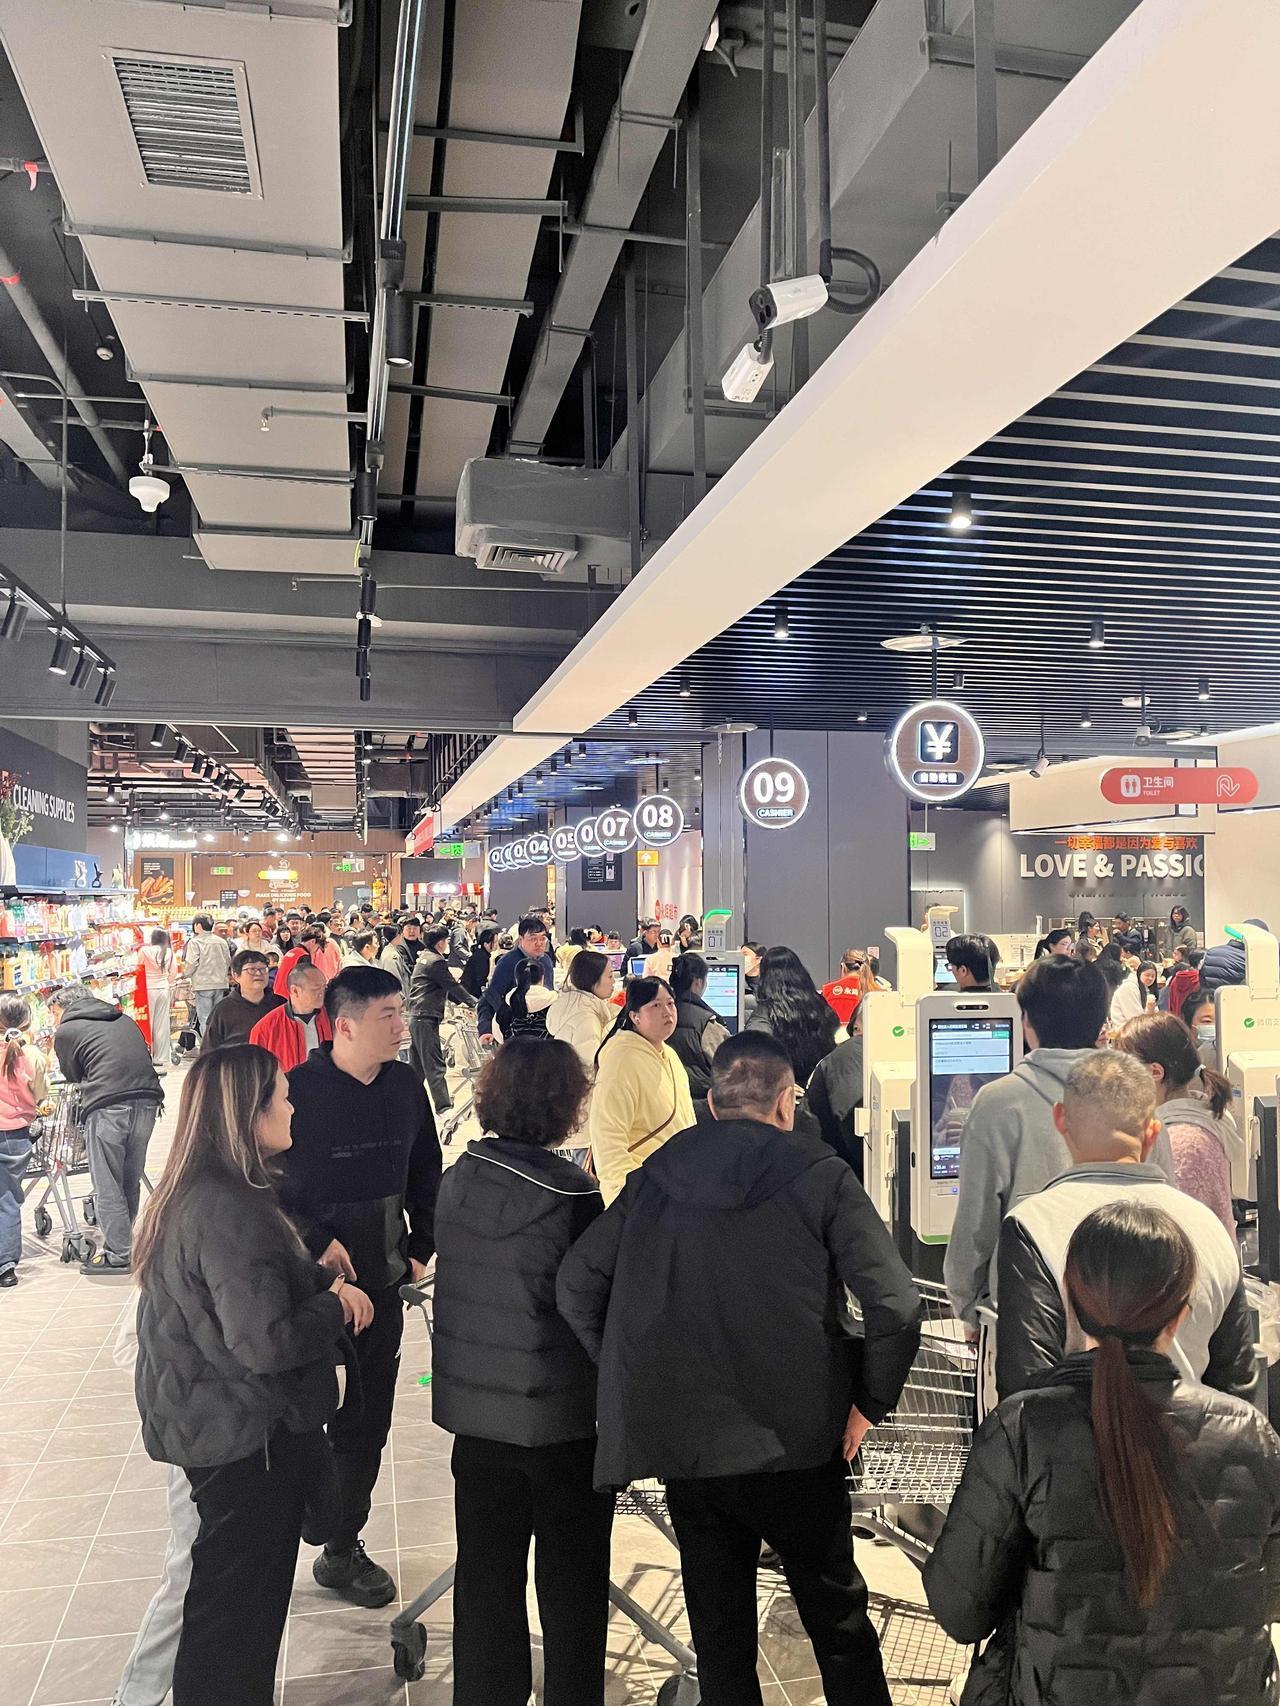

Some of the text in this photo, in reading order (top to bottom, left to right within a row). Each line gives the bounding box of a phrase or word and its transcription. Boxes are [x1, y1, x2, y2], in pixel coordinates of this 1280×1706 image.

[753, 772, 795, 803] 09
[1143, 776, 1174, 788] 卫生间
[13, 784, 75, 823] CLEANING SUPPLIES
[602, 816, 630, 837] 07
[643, 804, 674, 828] 08
[529, 839, 549, 854] 04
[1020, 854, 1088, 878] LOVE
[1093, 853, 1115, 878] &
[934, 926, 948, 938] 02
